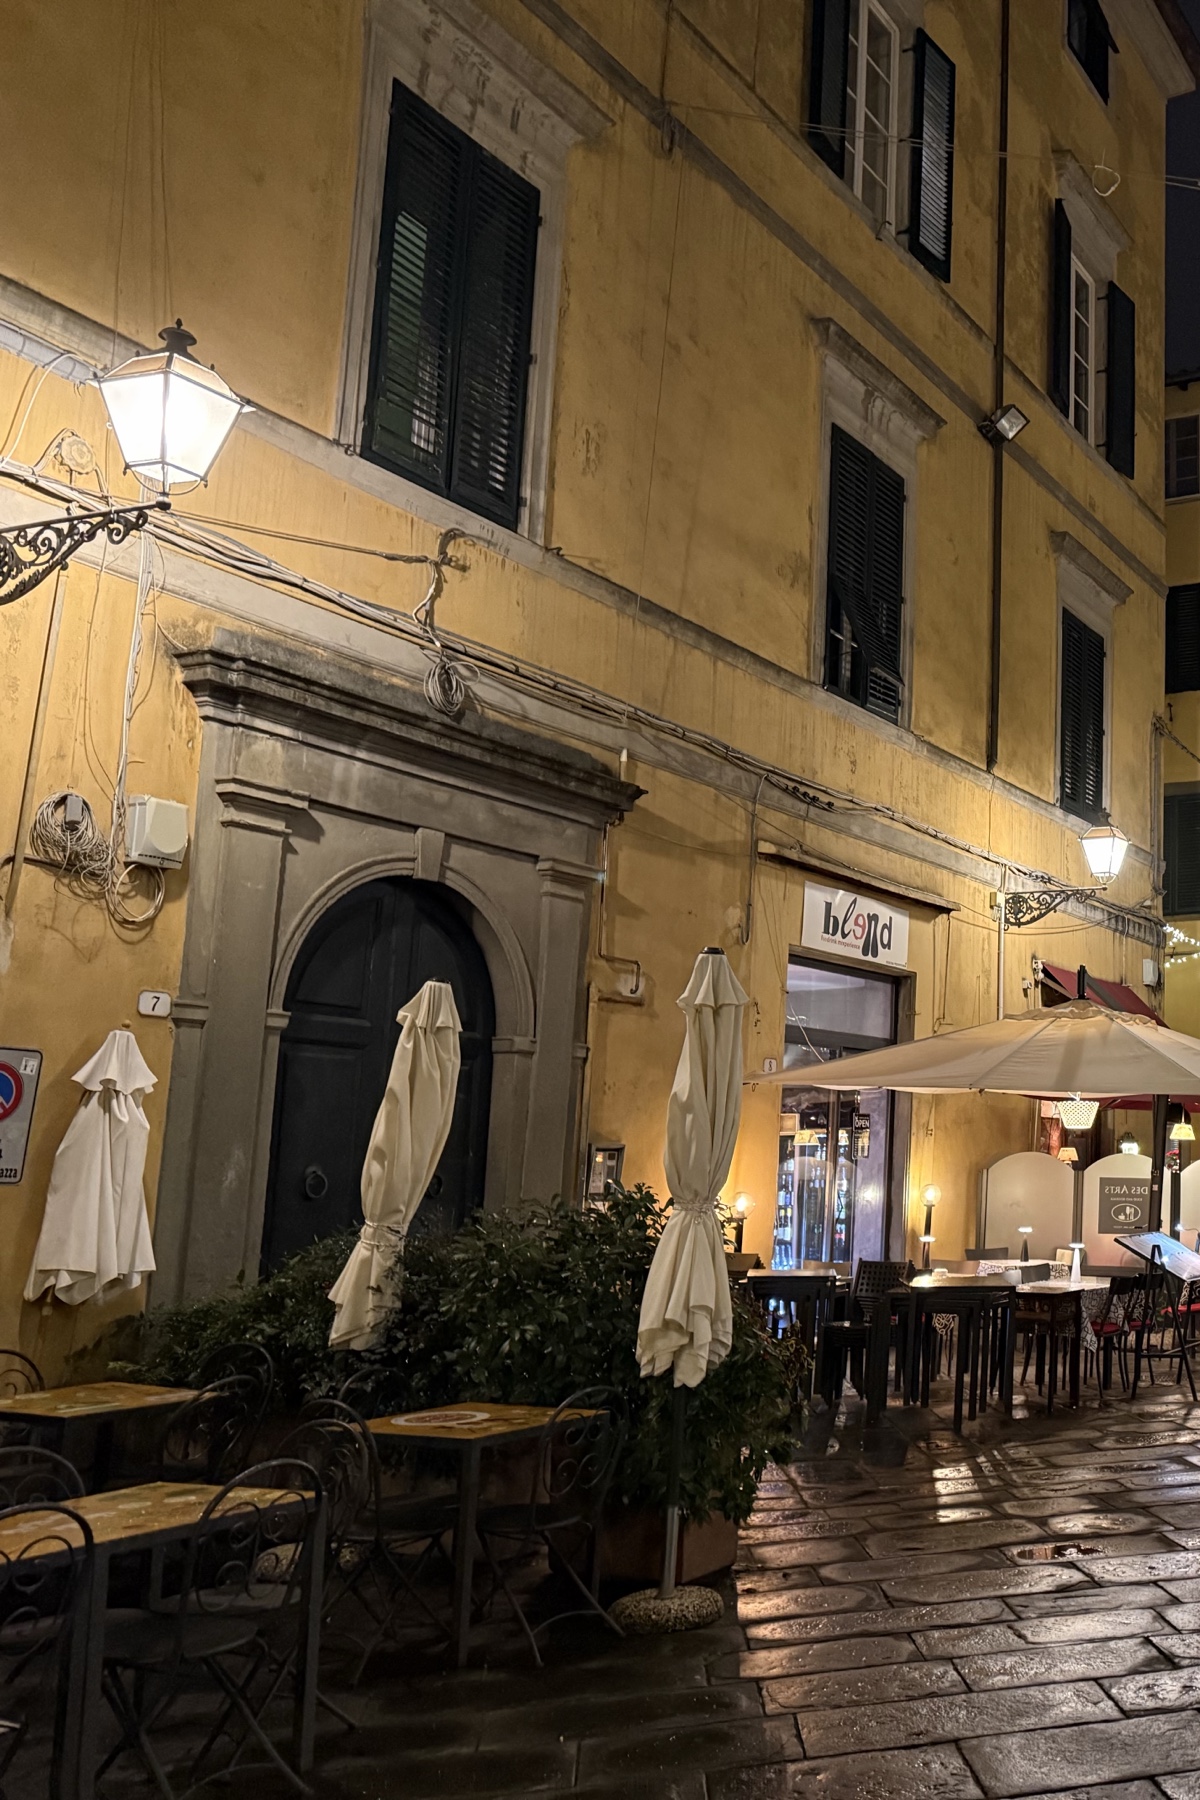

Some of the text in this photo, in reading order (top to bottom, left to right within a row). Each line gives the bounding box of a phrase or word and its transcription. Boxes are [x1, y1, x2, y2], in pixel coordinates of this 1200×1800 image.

[822, 897, 893, 958] blend
[150, 996, 160, 1012] 7
[855, 1119, 870, 1128] OPEN
